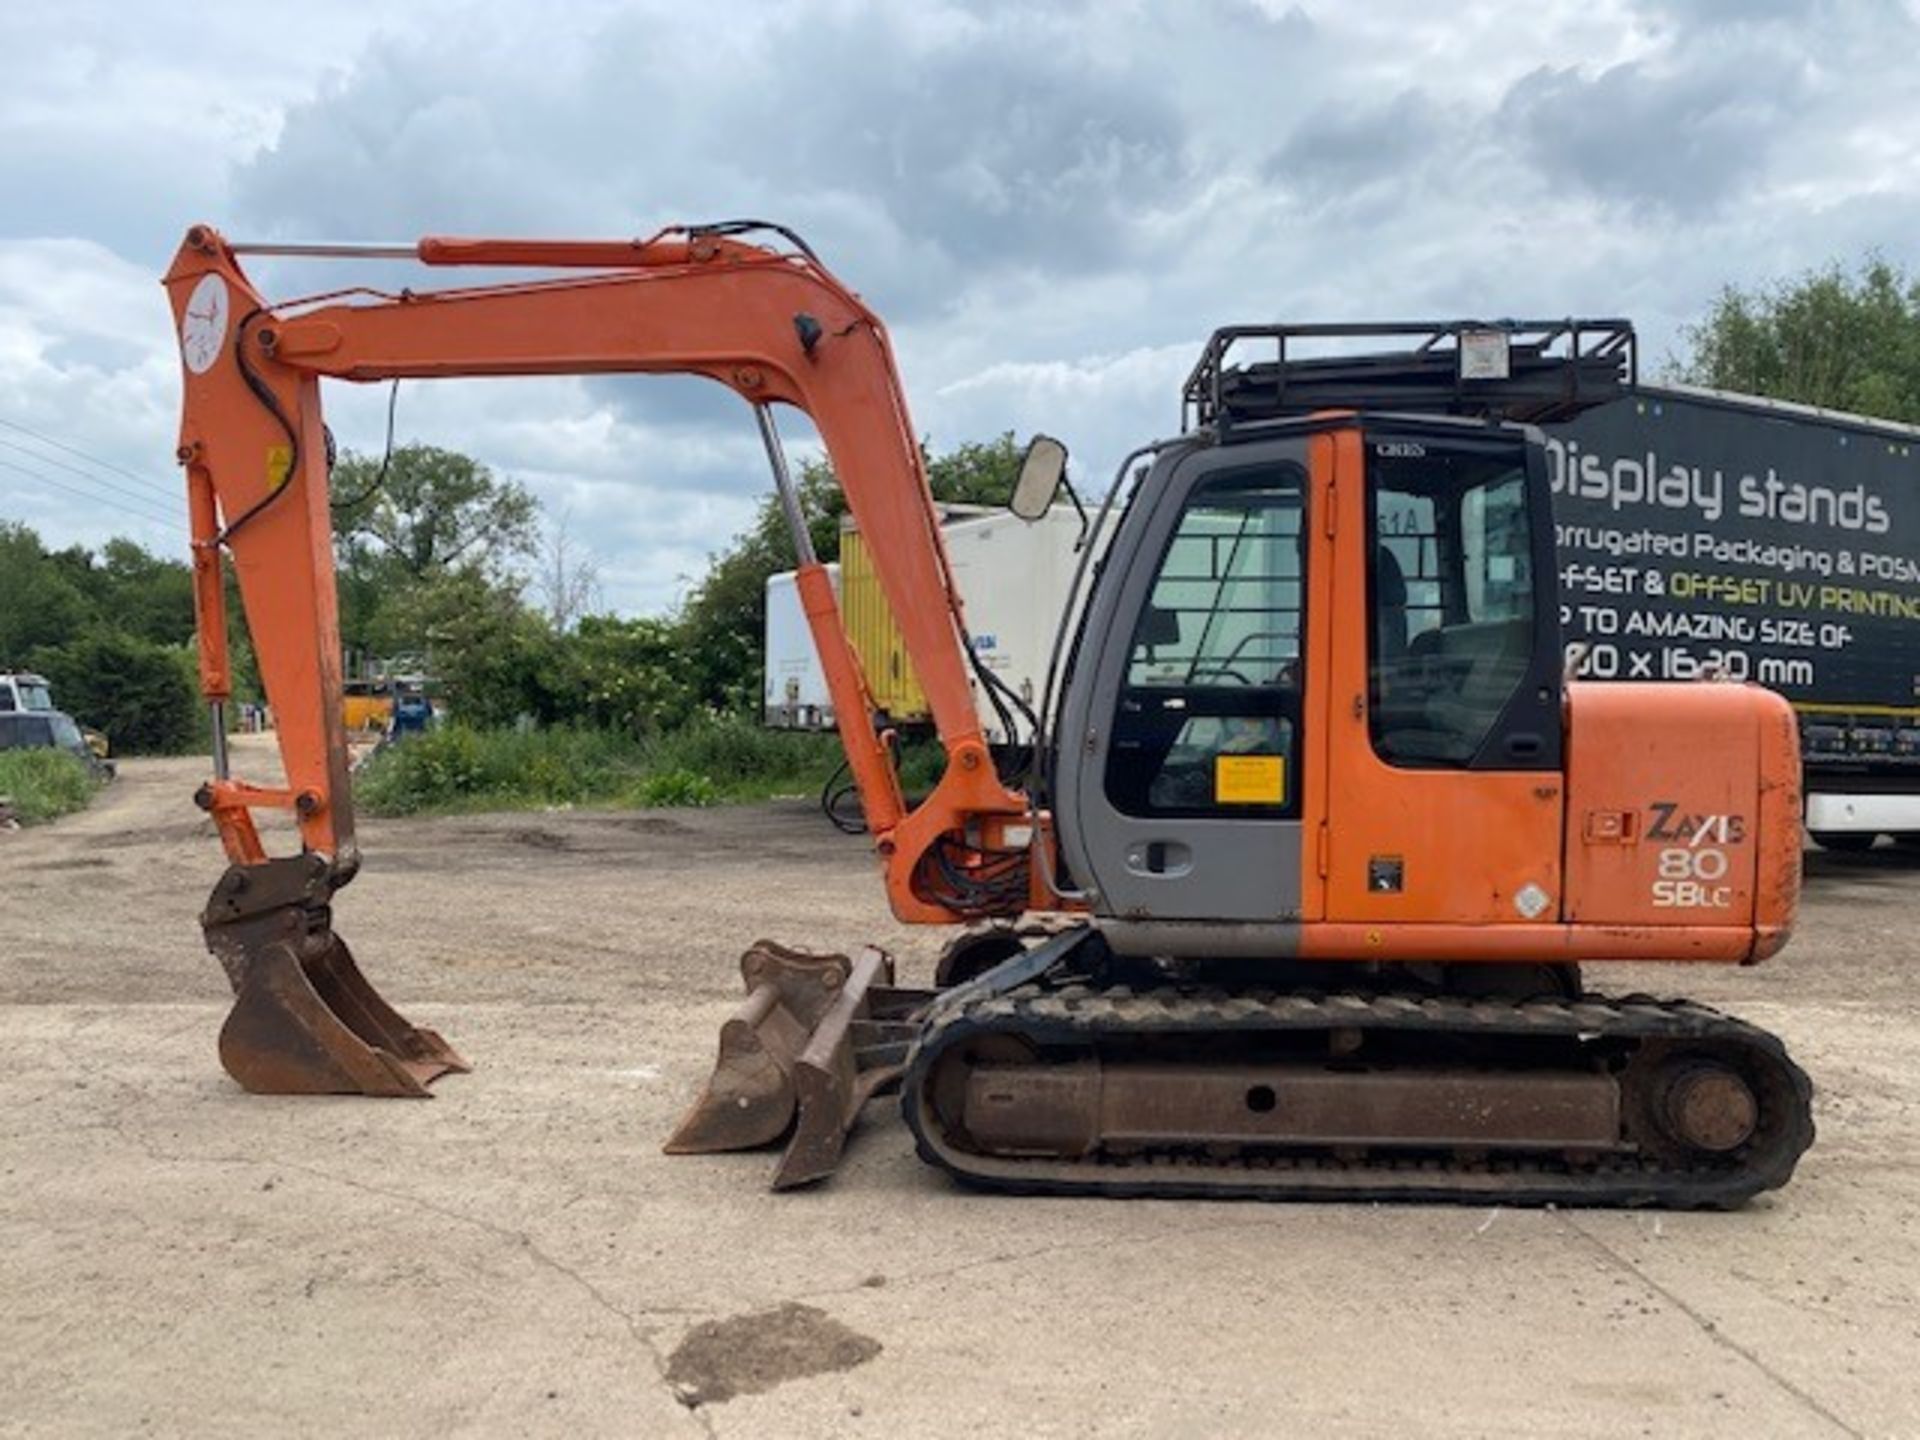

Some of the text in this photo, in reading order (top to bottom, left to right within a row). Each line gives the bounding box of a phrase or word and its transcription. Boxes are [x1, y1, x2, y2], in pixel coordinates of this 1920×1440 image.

[1547, 437, 1890, 533] Display stands
[1694, 533, 1833, 576] Packaging
[1836, 550, 1855, 575] &
[1559, 564, 1638, 592] FSET
[1644, 569, 1665, 595] &
[1670, 571, 1770, 604] OFFSET
[1776, 581, 1815, 608] UV
[1579, 605, 1618, 634] TO
[1625, 610, 1755, 642] AMAZING
[1760, 618, 1815, 645] SIZE
[1820, 623, 1852, 648] OF
[1663, 646, 1749, 682] 1620
[1758, 658, 1813, 685] mm
[1645, 803, 1745, 846] ZAXIS
[1658, 848, 1728, 880] 80
